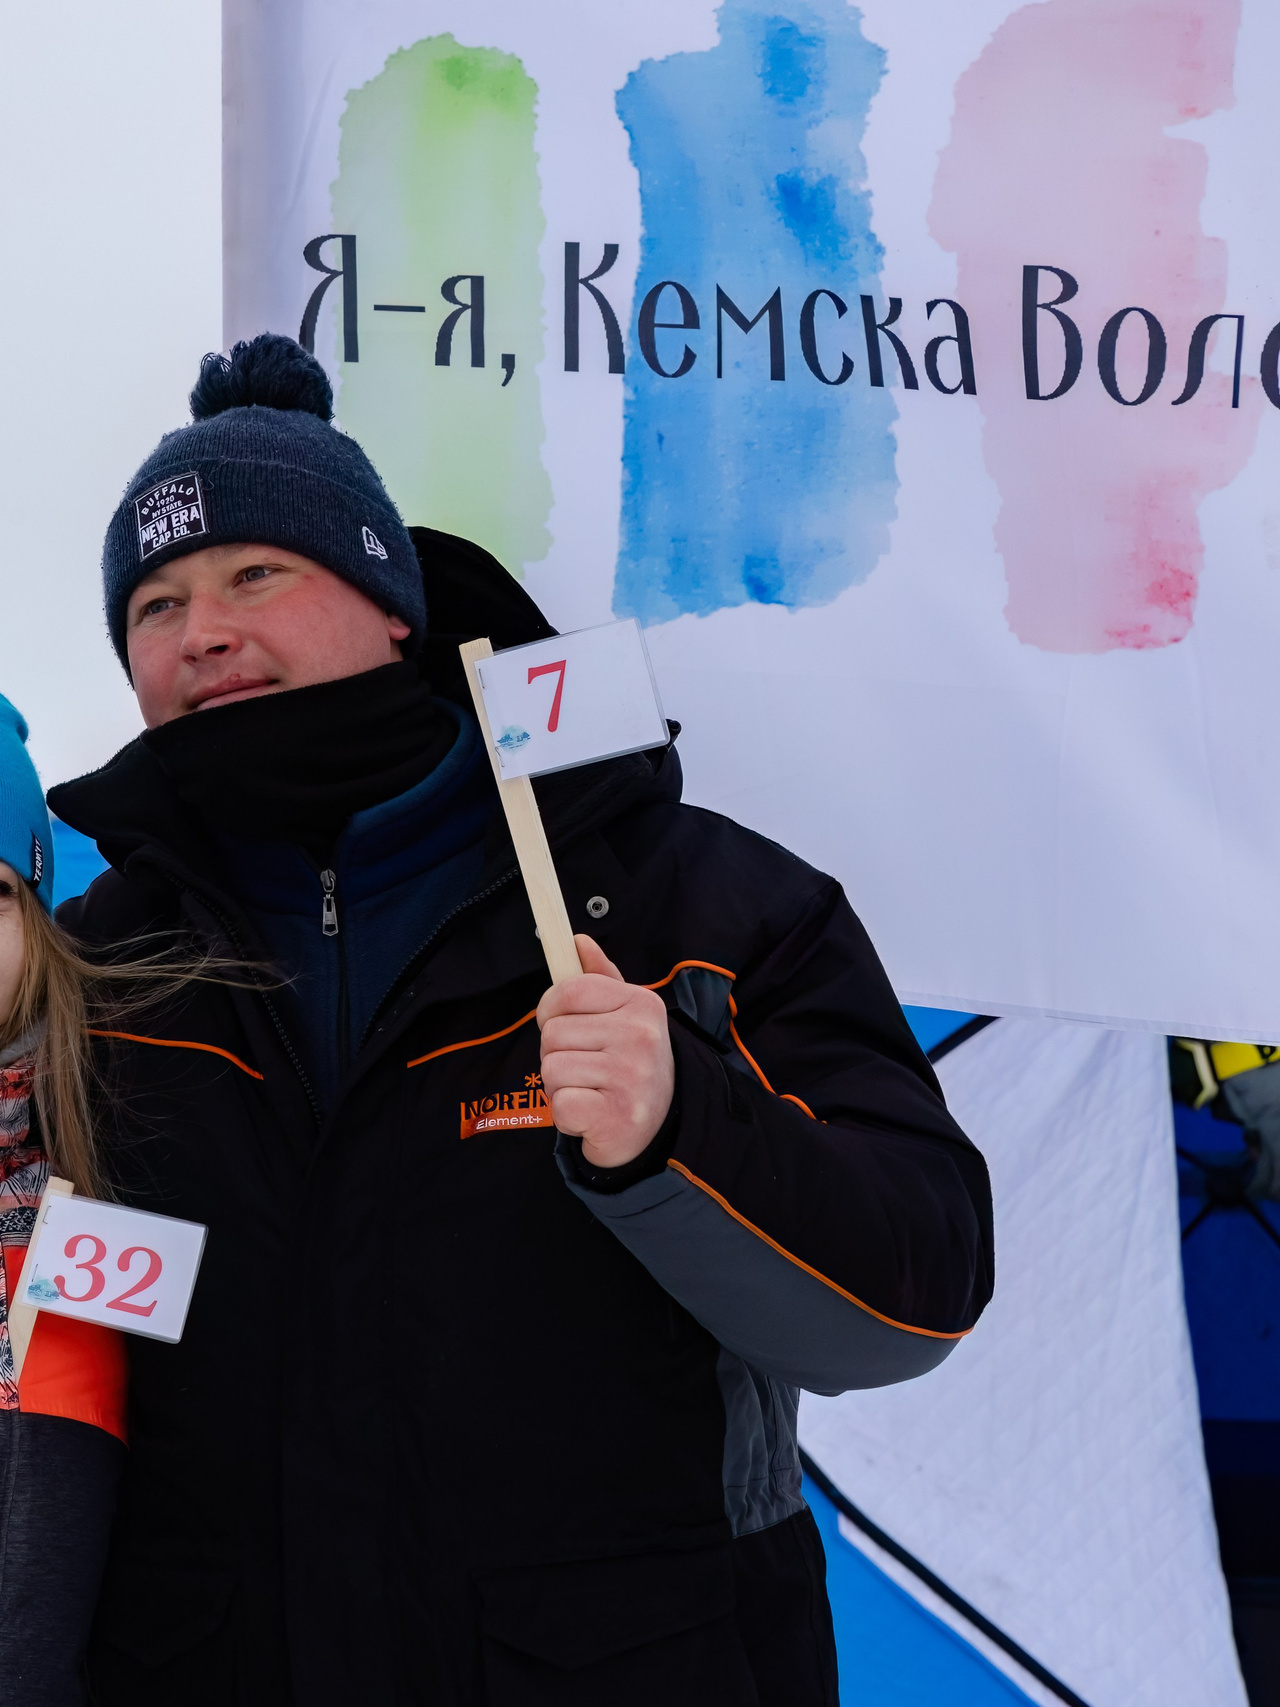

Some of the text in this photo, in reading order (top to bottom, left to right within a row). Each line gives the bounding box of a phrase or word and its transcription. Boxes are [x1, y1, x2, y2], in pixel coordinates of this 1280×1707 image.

[564, 241, 978, 395] Кемска
[141, 483, 195, 515] BUFFALO
[156, 495, 175, 507] 1920
[141, 505, 200, 544] NEW ERA
[152, 524, 191, 549] CAP CO.
[527, 659, 567, 733] 7
[476, 1114, 543, 1130] Element+
[53, 1233, 163, 1318] 32
